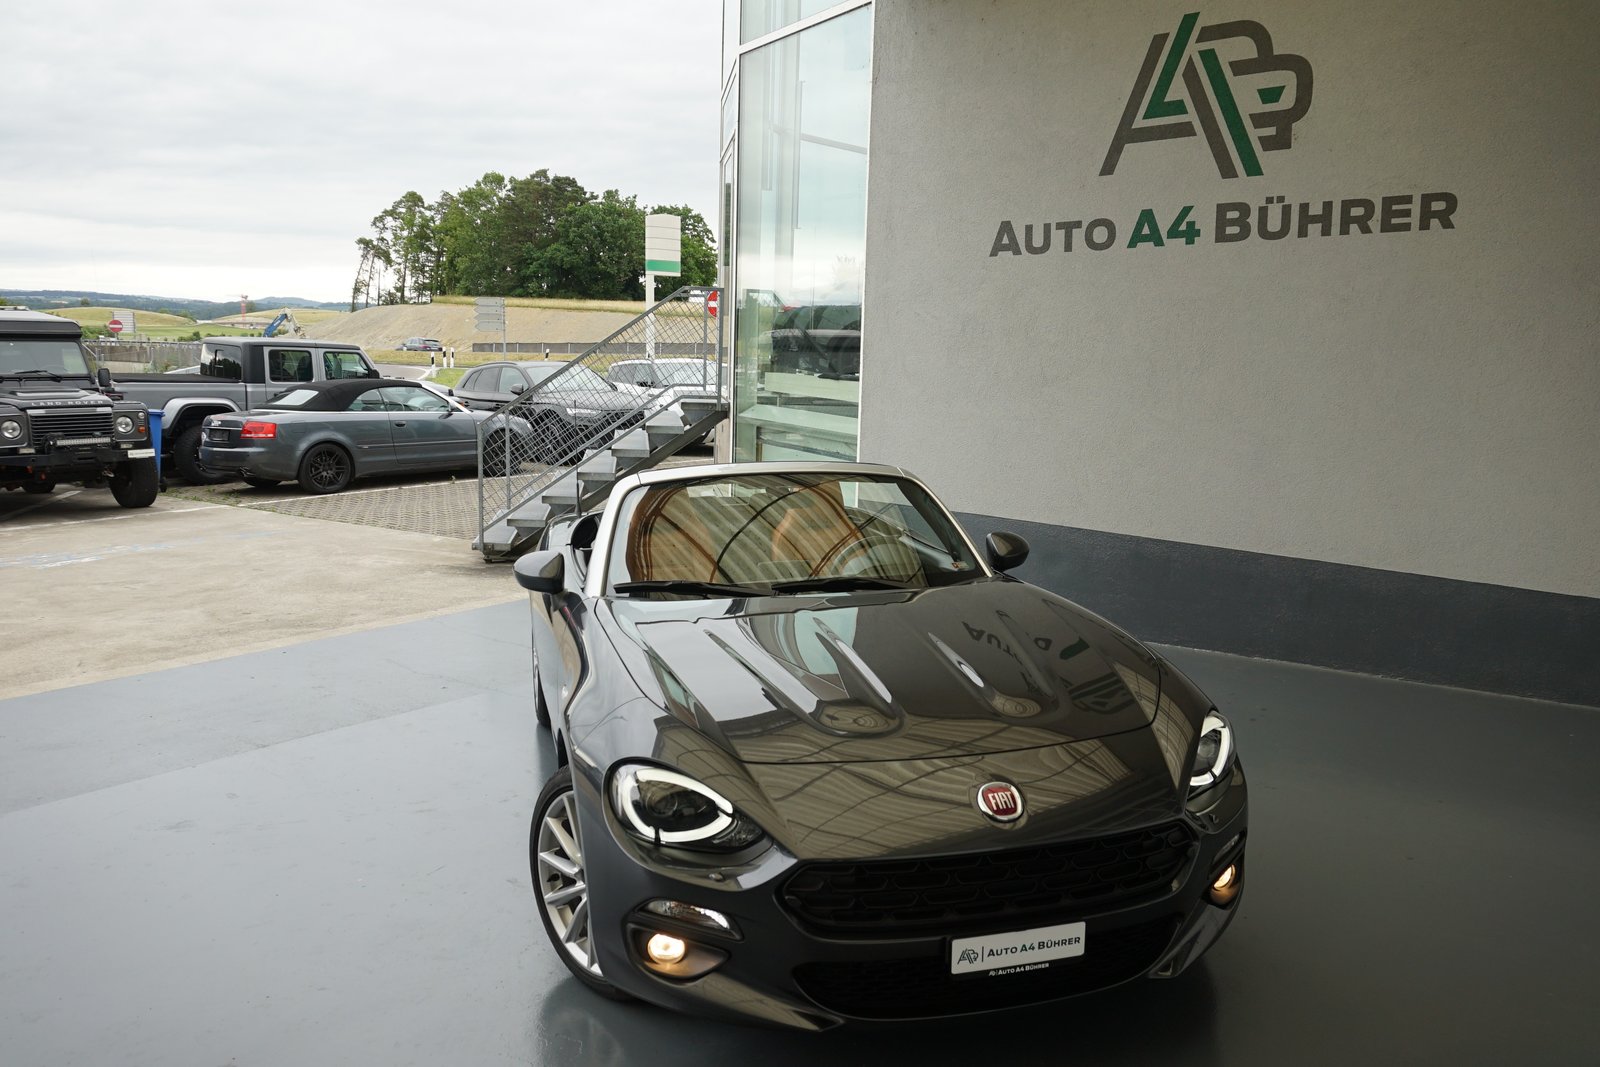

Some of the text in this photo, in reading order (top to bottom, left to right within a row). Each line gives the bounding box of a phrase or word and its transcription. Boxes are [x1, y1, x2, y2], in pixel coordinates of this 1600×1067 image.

[989, 192, 1459, 257] AUTO A4 BÜHRER
[987, 791, 1015, 811] FIAT
[987, 946, 1018, 958] AUTO
[1020, 943, 1036, 953] A4
[1037, 936, 1081, 950] BÜHRER
[998, 968, 1015, 976] AUTO
[1025, 962, 1050, 972] BÜHRER
